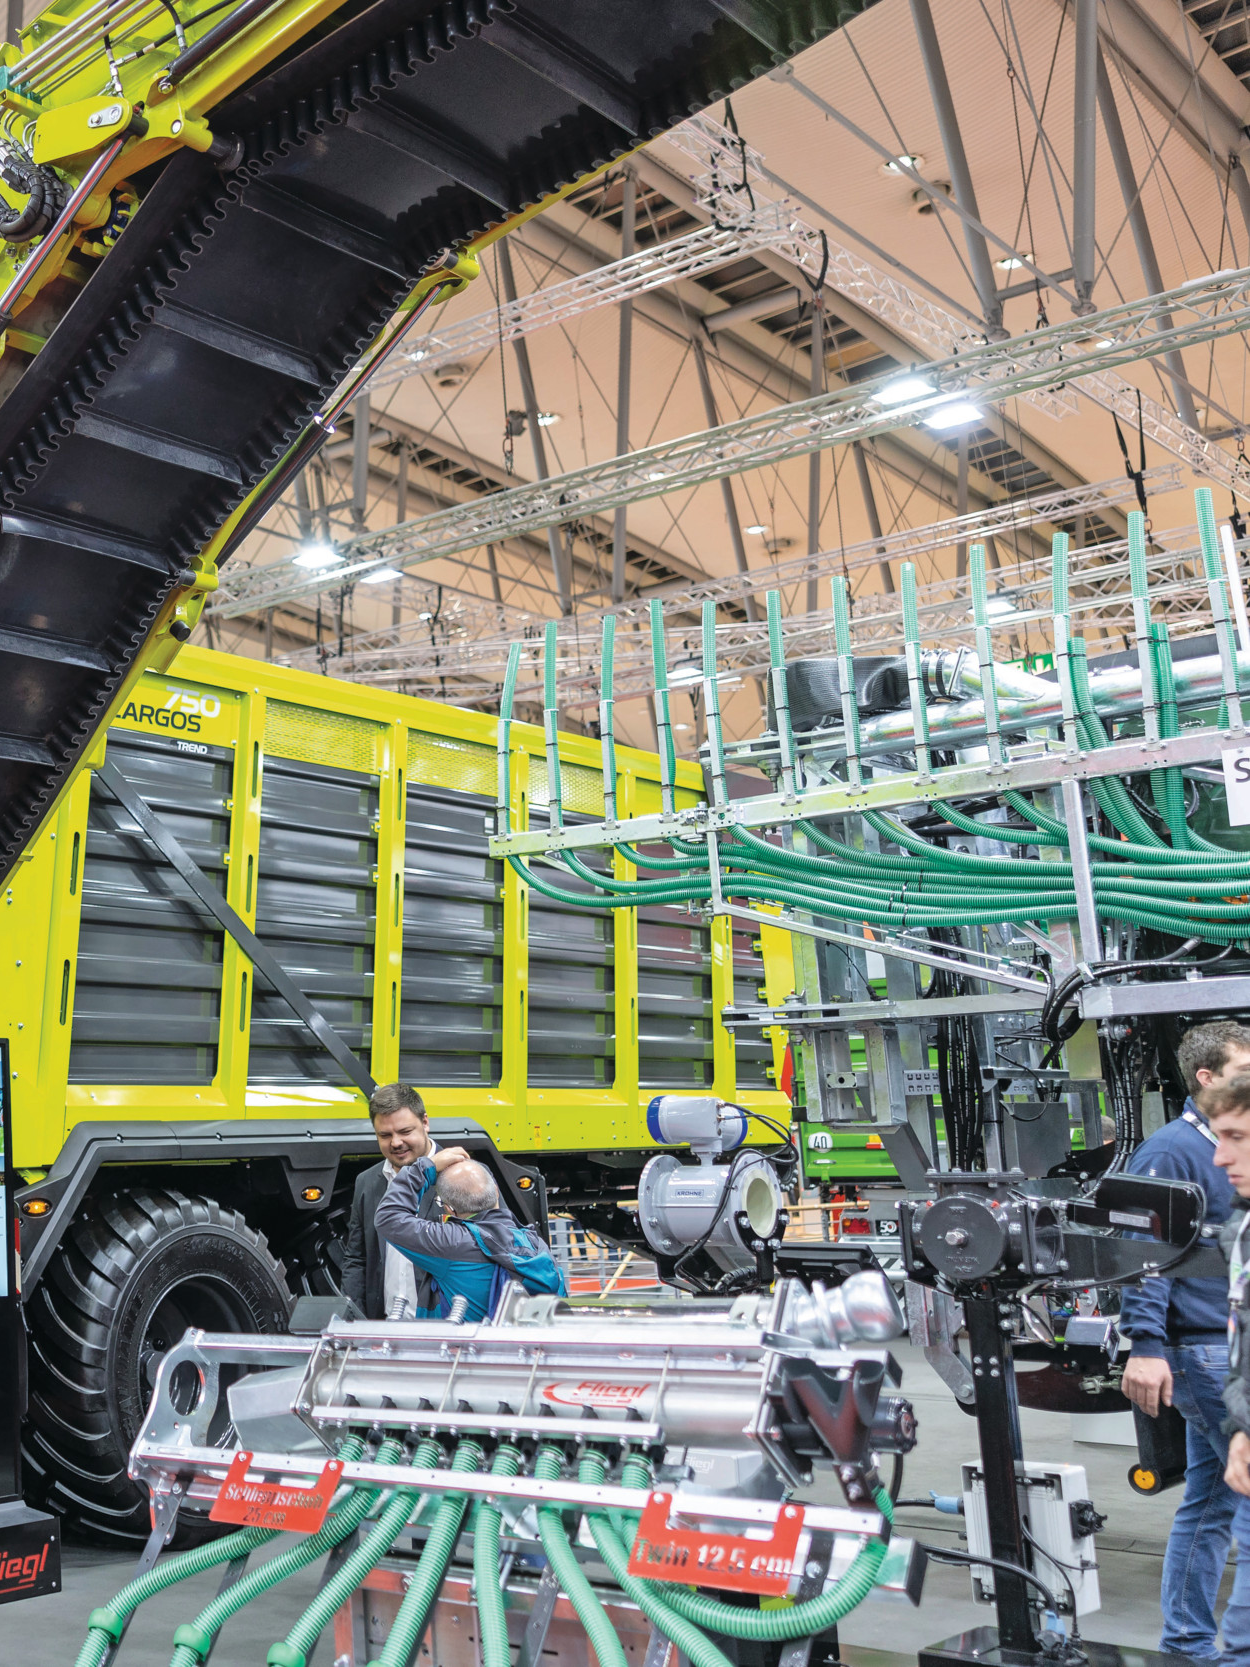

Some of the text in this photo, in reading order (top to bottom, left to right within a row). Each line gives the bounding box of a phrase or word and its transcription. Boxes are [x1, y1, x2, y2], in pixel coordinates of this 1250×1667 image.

[164, 685, 221, 718] 750
[115, 702, 202, 733] ARGOS
[176, 741, 208, 755] TREND
[813, 1135, 828, 1149] 40
[880, 1220, 897, 1233] 50
[572, 1380, 652, 1404] Fliegl
[635, 1538, 793, 1580] Twin 12.5 cm
